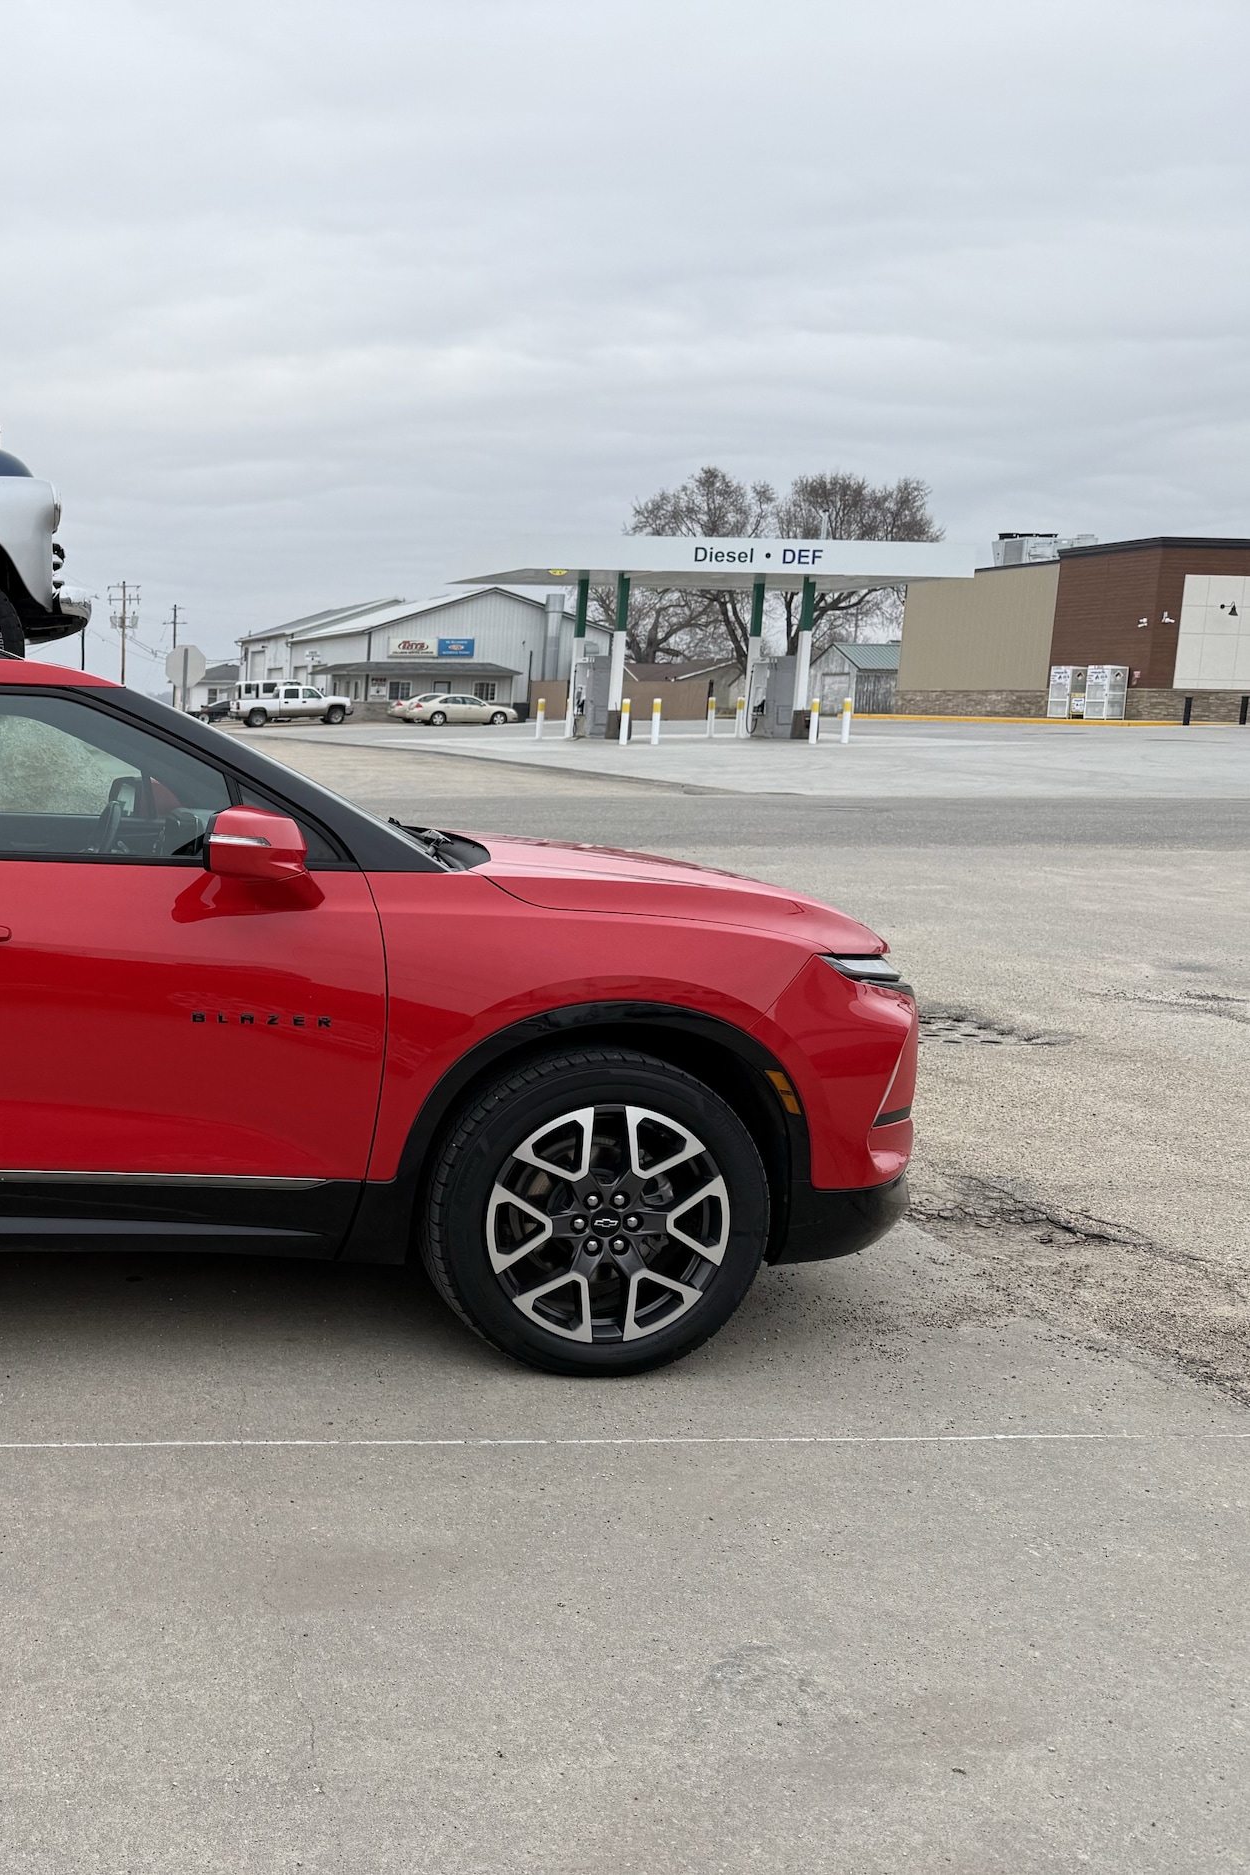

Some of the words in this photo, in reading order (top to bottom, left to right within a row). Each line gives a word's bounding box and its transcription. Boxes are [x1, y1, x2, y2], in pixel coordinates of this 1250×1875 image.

[694, 547, 754, 563] Diesel
[782, 549, 824, 565] DEF
[191, 1011, 332, 1028] BLAZER
